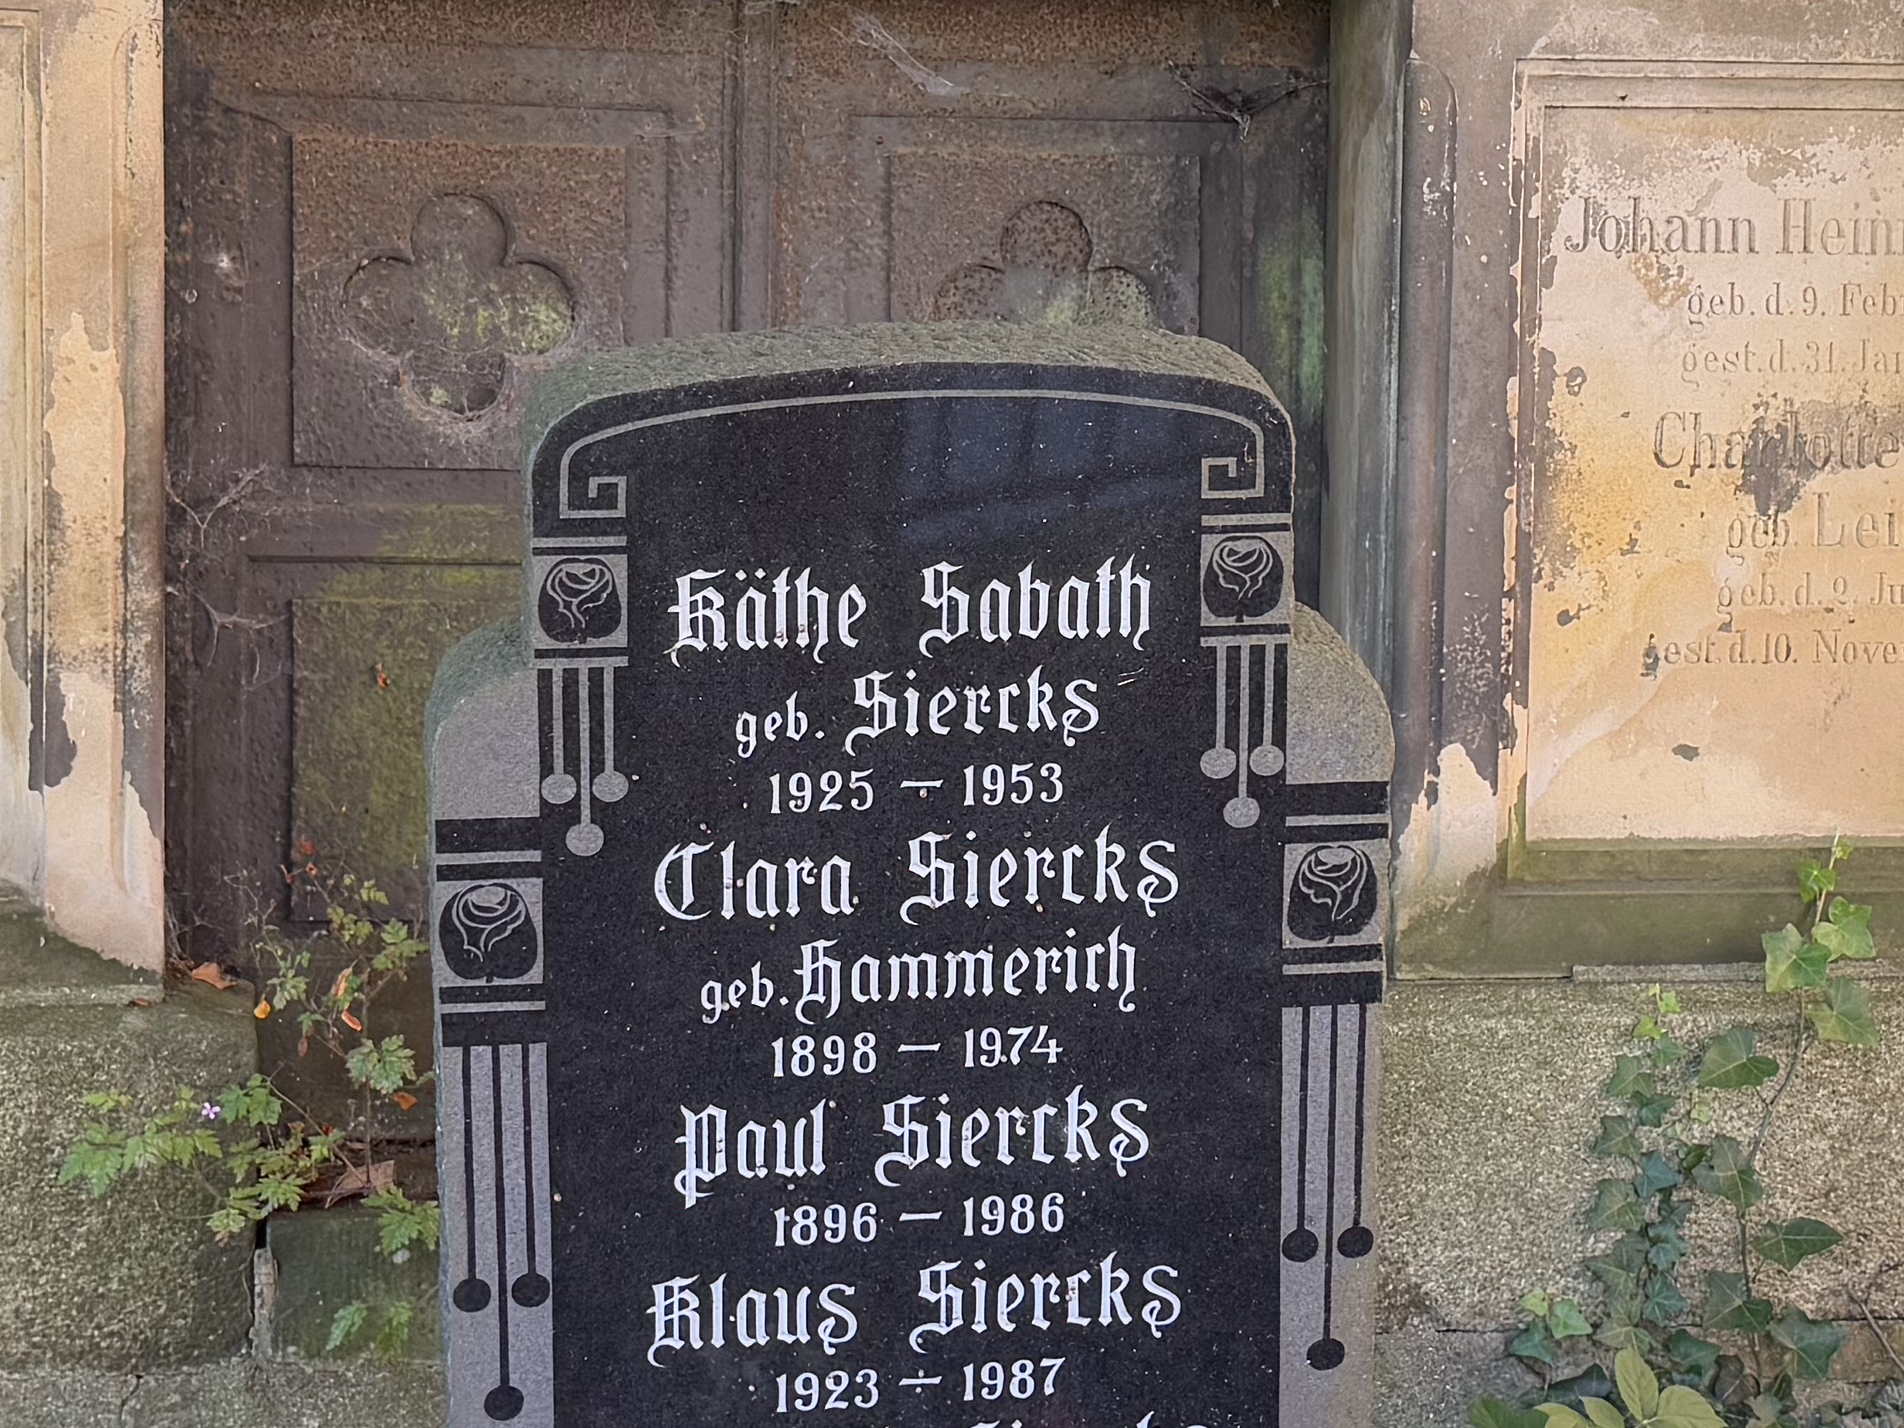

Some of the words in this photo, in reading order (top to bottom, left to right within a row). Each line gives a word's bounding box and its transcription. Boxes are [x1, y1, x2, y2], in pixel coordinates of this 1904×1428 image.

[1564, 196, 1759, 258] Johann
[1653, 410, 1901, 470] Charlotte
[664, 567, 867, 667] Käthe
[917, 552, 1152, 660] Sabath
[734, 689, 826, 760] geb.
[843, 663, 1100, 758] Siercks
[768, 767, 875, 815] 1925
[962, 761, 1064, 807] 1953
[653, 839, 856, 922] Clara
[898, 822, 1180, 927] Siercks
[699, 965, 790, 1026] geb.
[794, 923, 1137, 1019] Hammerich
[770, 1030, 878, 1079] 1898
[963, 1024, 1065, 1069] 1974
[674, 1099, 827, 1209] Paul
[873, 1083, 1150, 1188] Siercks
[772, 1202, 878, 1248] 1896
[962, 1191, 1065, 1238] 1986
[646, 1273, 859, 1367] Klaus
[907, 1249, 1182, 1355] Siercks
[774, 1368, 880, 1414] 1923
[962, 1356, 1067, 1403] 1987
